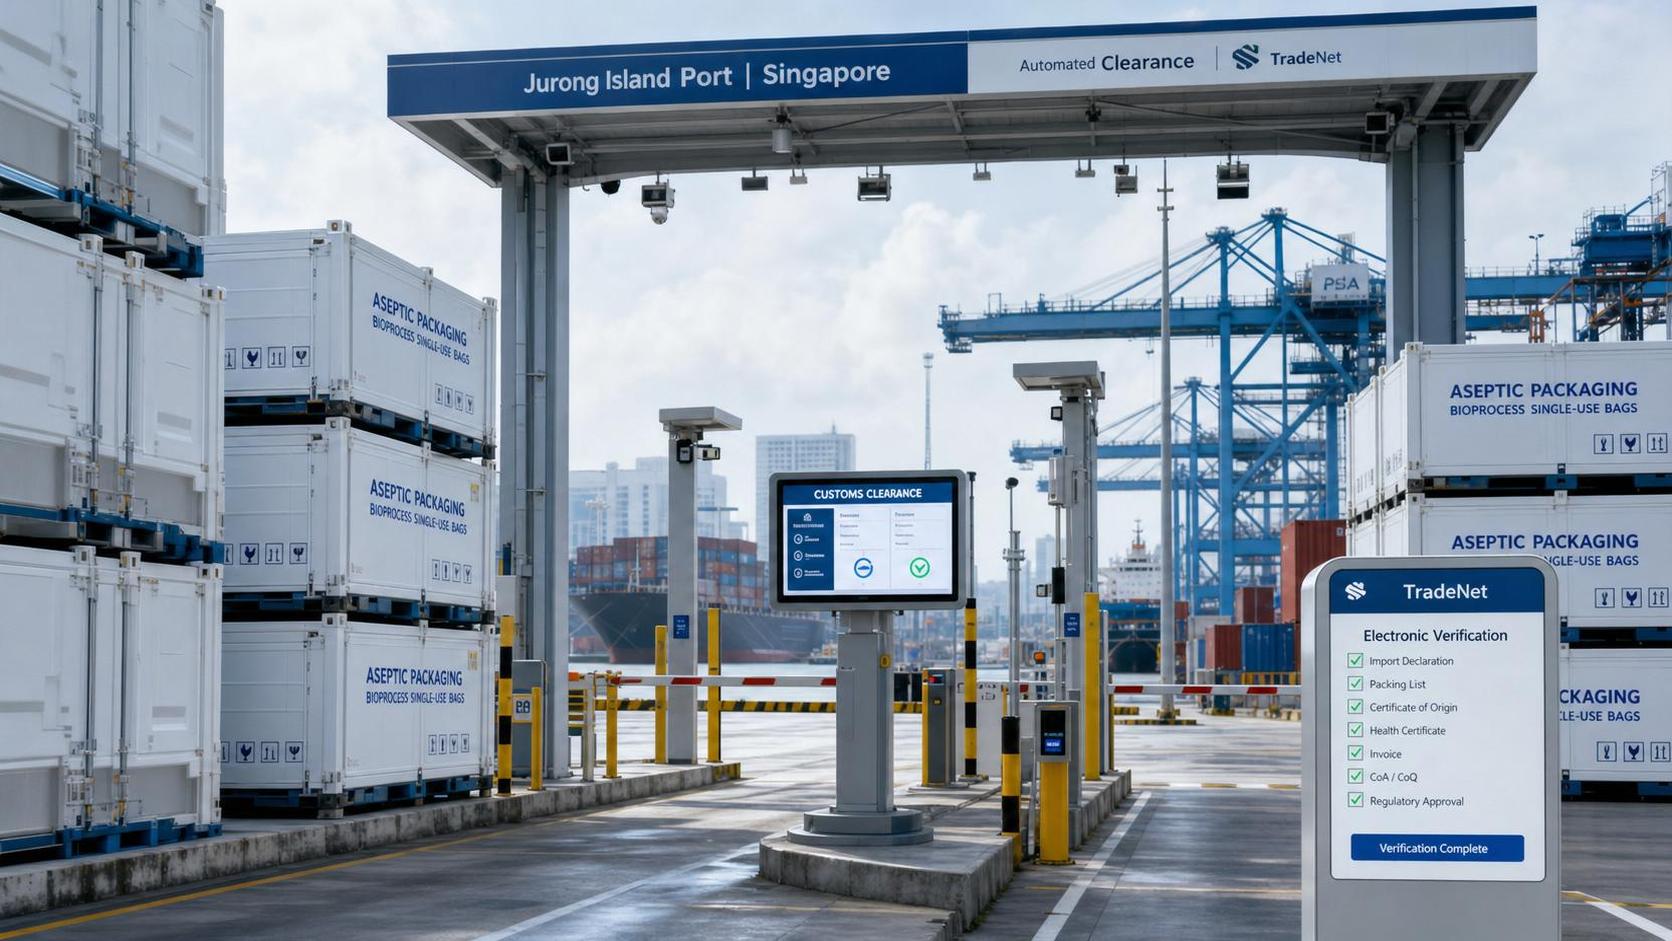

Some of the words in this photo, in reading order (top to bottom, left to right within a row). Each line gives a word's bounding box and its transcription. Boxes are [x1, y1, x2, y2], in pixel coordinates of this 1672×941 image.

[1020, 57, 1095, 72] Automated
[1101, 55, 1195, 70] Clearance
[1270, 51, 1342, 65] TradeNet
[524, 73, 599, 96] Jurong
[606, 67, 670, 90] Island
[681, 66, 733, 88] Port
[763, 63, 891, 89] Singapore
[1324, 276, 1359, 291] PSA
[373, 292, 414, 323] ASEPTIC
[417, 312, 467, 346] PACKAGING
[453, 349, 470, 365] BAGS
[1450, 384, 1524, 398] ASEPTIC
[1531, 382, 1637, 397] PACKAGING
[1450, 404, 1525, 416] BIOPROCESS
[1531, 403, 1600, 415] SINGLE-USE
[1605, 403, 1637, 413] BAGS
[370, 479, 411, 504] ASEPTIC
[415, 490, 465, 517] PACKAGING
[814, 489, 864, 500] CUSTOMS
[866, 488, 922, 499] CLEARANCE
[370, 503, 412, 523] BIOPROCESS
[414, 513, 450, 531] SINGLE-USE
[452, 522, 467, 535] BAGS
[1452, 535, 1525, 550] ASEPTIC
[1533, 534, 1639, 549] PACKAGING
[1544, 555, 1601, 567] NGLE-USE
[1606, 555, 1639, 566] BAGS
[1403, 583, 1488, 600] TradeNet
[1364, 629, 1429, 642] Electronic
[1433, 629, 1508, 642] Verification
[1369, 657, 1400, 668] Import
[1402, 656, 1454, 666] Declaration
[366, 667, 408, 684] ASEPTIC
[410, 669, 462, 686] PACKAGING
[1369, 679, 1406, 691] Packing
[1409, 680, 1426, 689] List
[366, 691, 408, 704] BIOPROCESS
[410, 692, 446, 704] SINGLE-USE
[449, 692, 465, 704] BAGS
[1559, 689, 1640, 704] CKAGING
[1369, 703, 1416, 712] Certificate
[1418, 702, 1428, 712] of
[1430, 703, 1458, 714] Origin
[1608, 711, 1640, 721] BAGS
[1369, 726, 1399, 735] Health
[1401, 726, 1447, 735] Certificate
[1369, 749, 1402, 759] Invoice
[1369, 773, 1389, 782] CoA
[1391, 772, 1396, 782] /
[1397, 773, 1418, 783] CoQ
[1369, 796, 1420, 808] Regulatory
[1422, 796, 1464, 808] Approval
[1379, 843, 1437, 854] Verification
[1439, 843, 1488, 856] Complete
